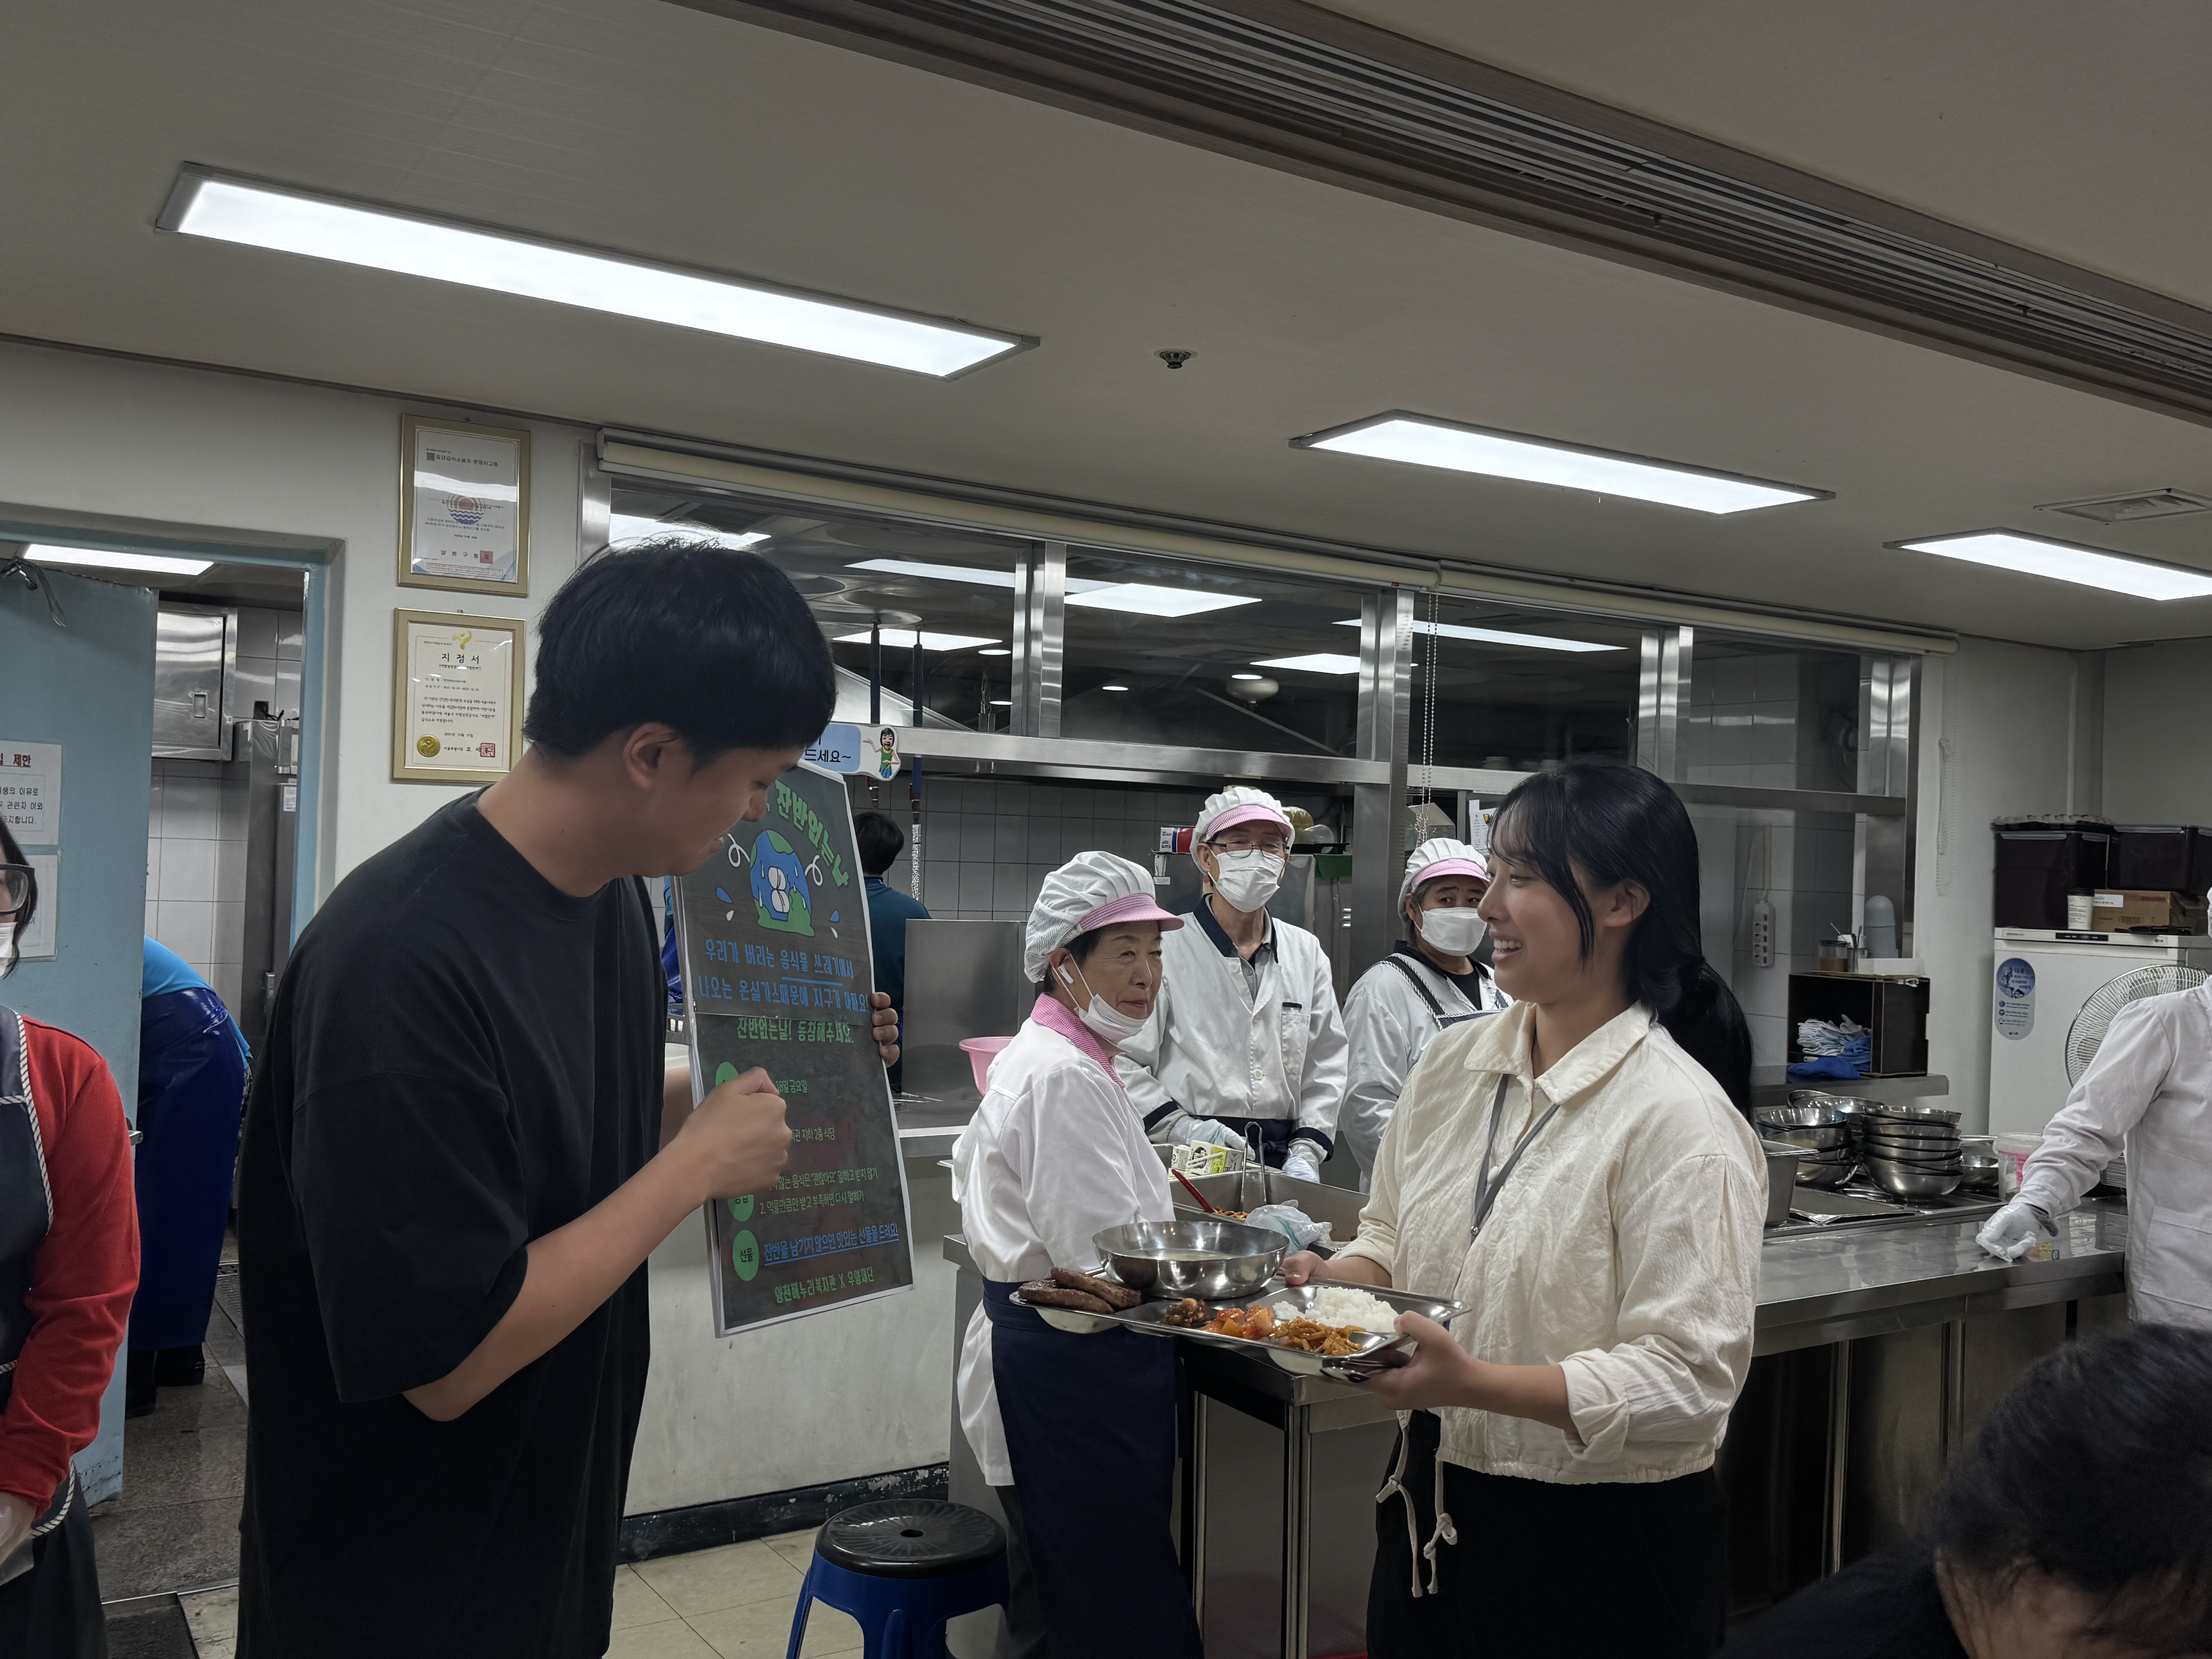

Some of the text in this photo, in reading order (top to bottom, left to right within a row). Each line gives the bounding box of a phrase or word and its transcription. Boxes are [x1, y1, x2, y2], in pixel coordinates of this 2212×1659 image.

[14, 754, 31, 768] 제한
[775, 780, 849, 887] 잔반없는날
[706, 939, 854, 979] 우리가 버리는 음식물 쓰레기에서
[699, 975, 732, 1000] 나오는
[813, 988, 841, 1008] 지구가
[844, 991, 869, 1013] 아파요!
[737, 1017, 792, 1041] 잔반없는날!
[776, 1080, 808, 1092] 18일 금요일
[802, 1128, 813, 1141] 지하
[814, 1127, 823, 1141] 2층
[824, 1127, 835, 1140] 식당
[792, 1174, 811, 1188] 음식은
[838, 1170, 854, 1183] 말하고
[855, 1168, 866, 1181] 받지
[867, 1166, 878, 1180] 않기
[767, 1197, 799, 1214] 먹을만큼만
[800, 1196, 812, 1210] 받고
[835, 1191, 847, 1203] 다시
[847, 1189, 865, 1204] 말하기
[764, 1223, 898, 1262] 잔반을 남기지 않으면 맛있는 선물을 드려요!
[740, 1247, 753, 1263] 선물
[848, 1267, 874, 1286] 우양재단
